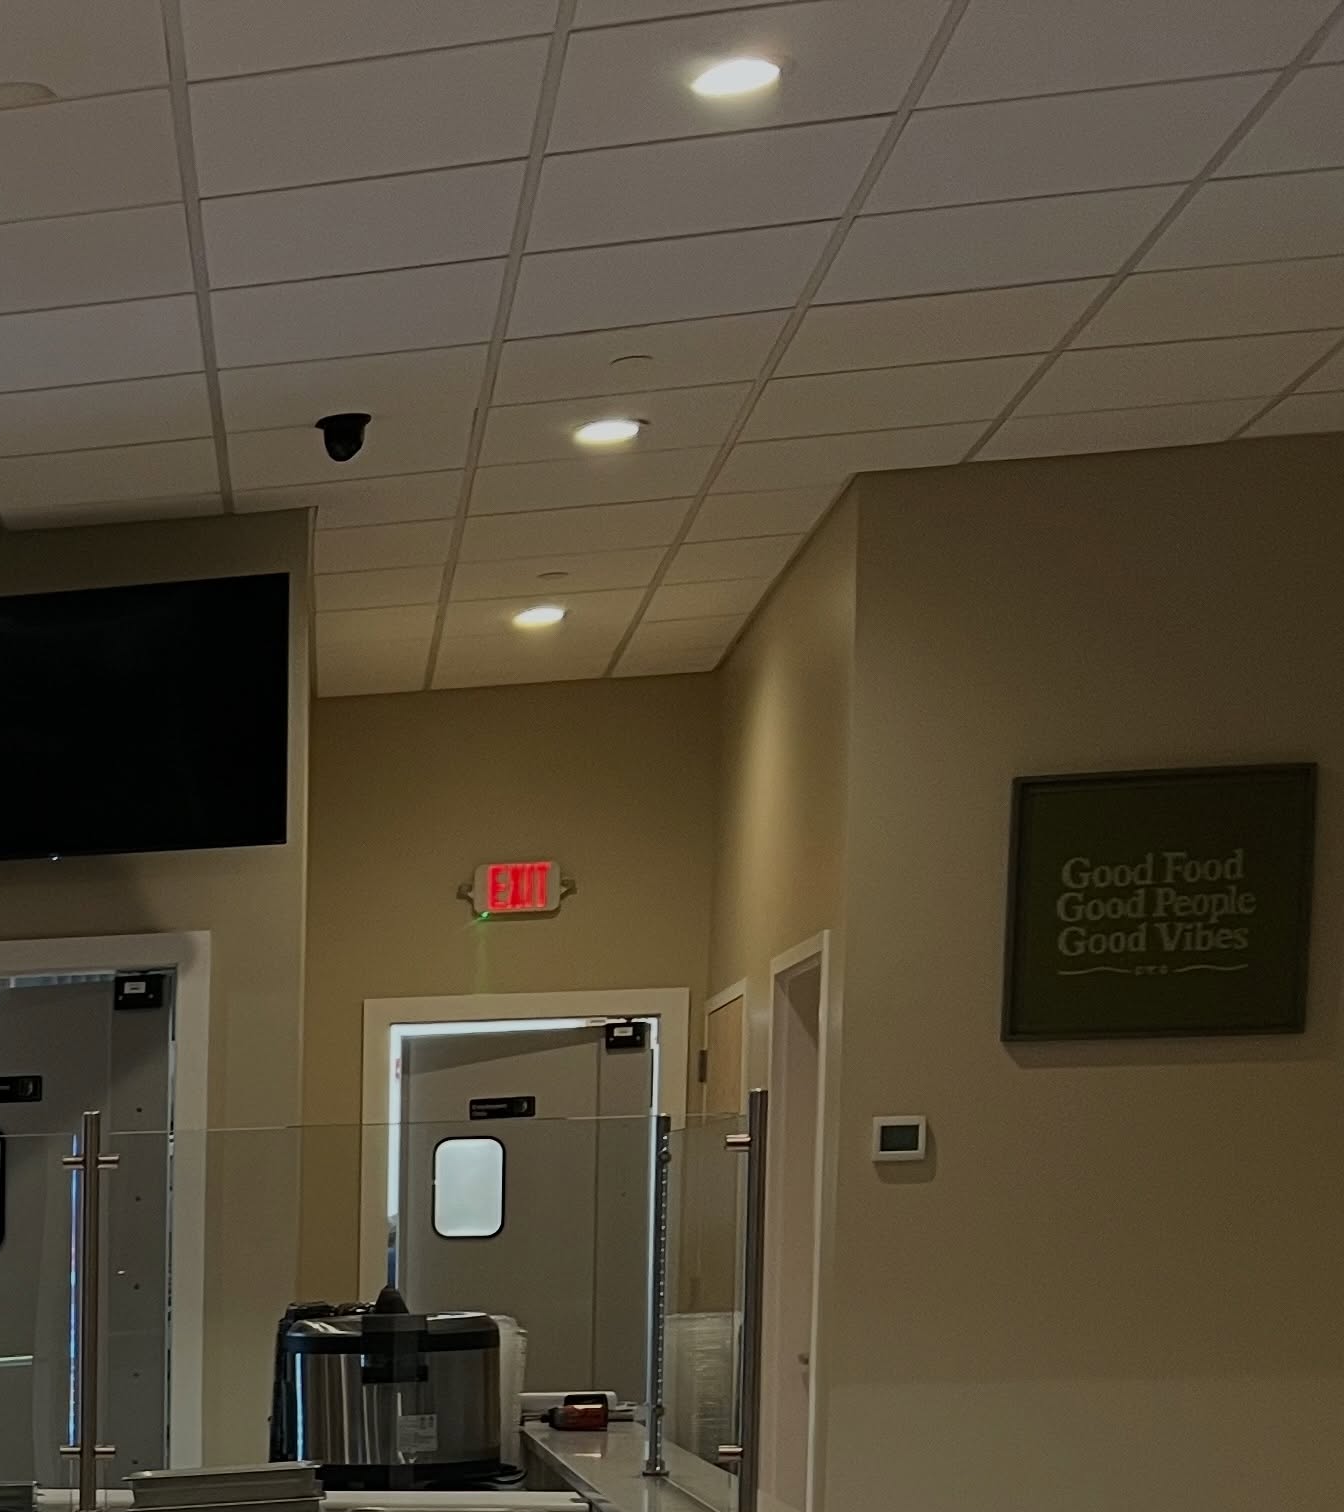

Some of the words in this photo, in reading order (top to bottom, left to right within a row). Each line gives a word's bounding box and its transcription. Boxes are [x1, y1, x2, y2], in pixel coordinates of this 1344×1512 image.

[488, 863, 550, 911] EXIT
[1062, 853, 1154, 888] Good
[1163, 848, 1245, 883] Food
[1056, 887, 1146, 922] Good
[1152, 885, 1257, 923] People
[1057, 923, 1148, 957] Good
[1154, 922, 1248, 951] Vibes
